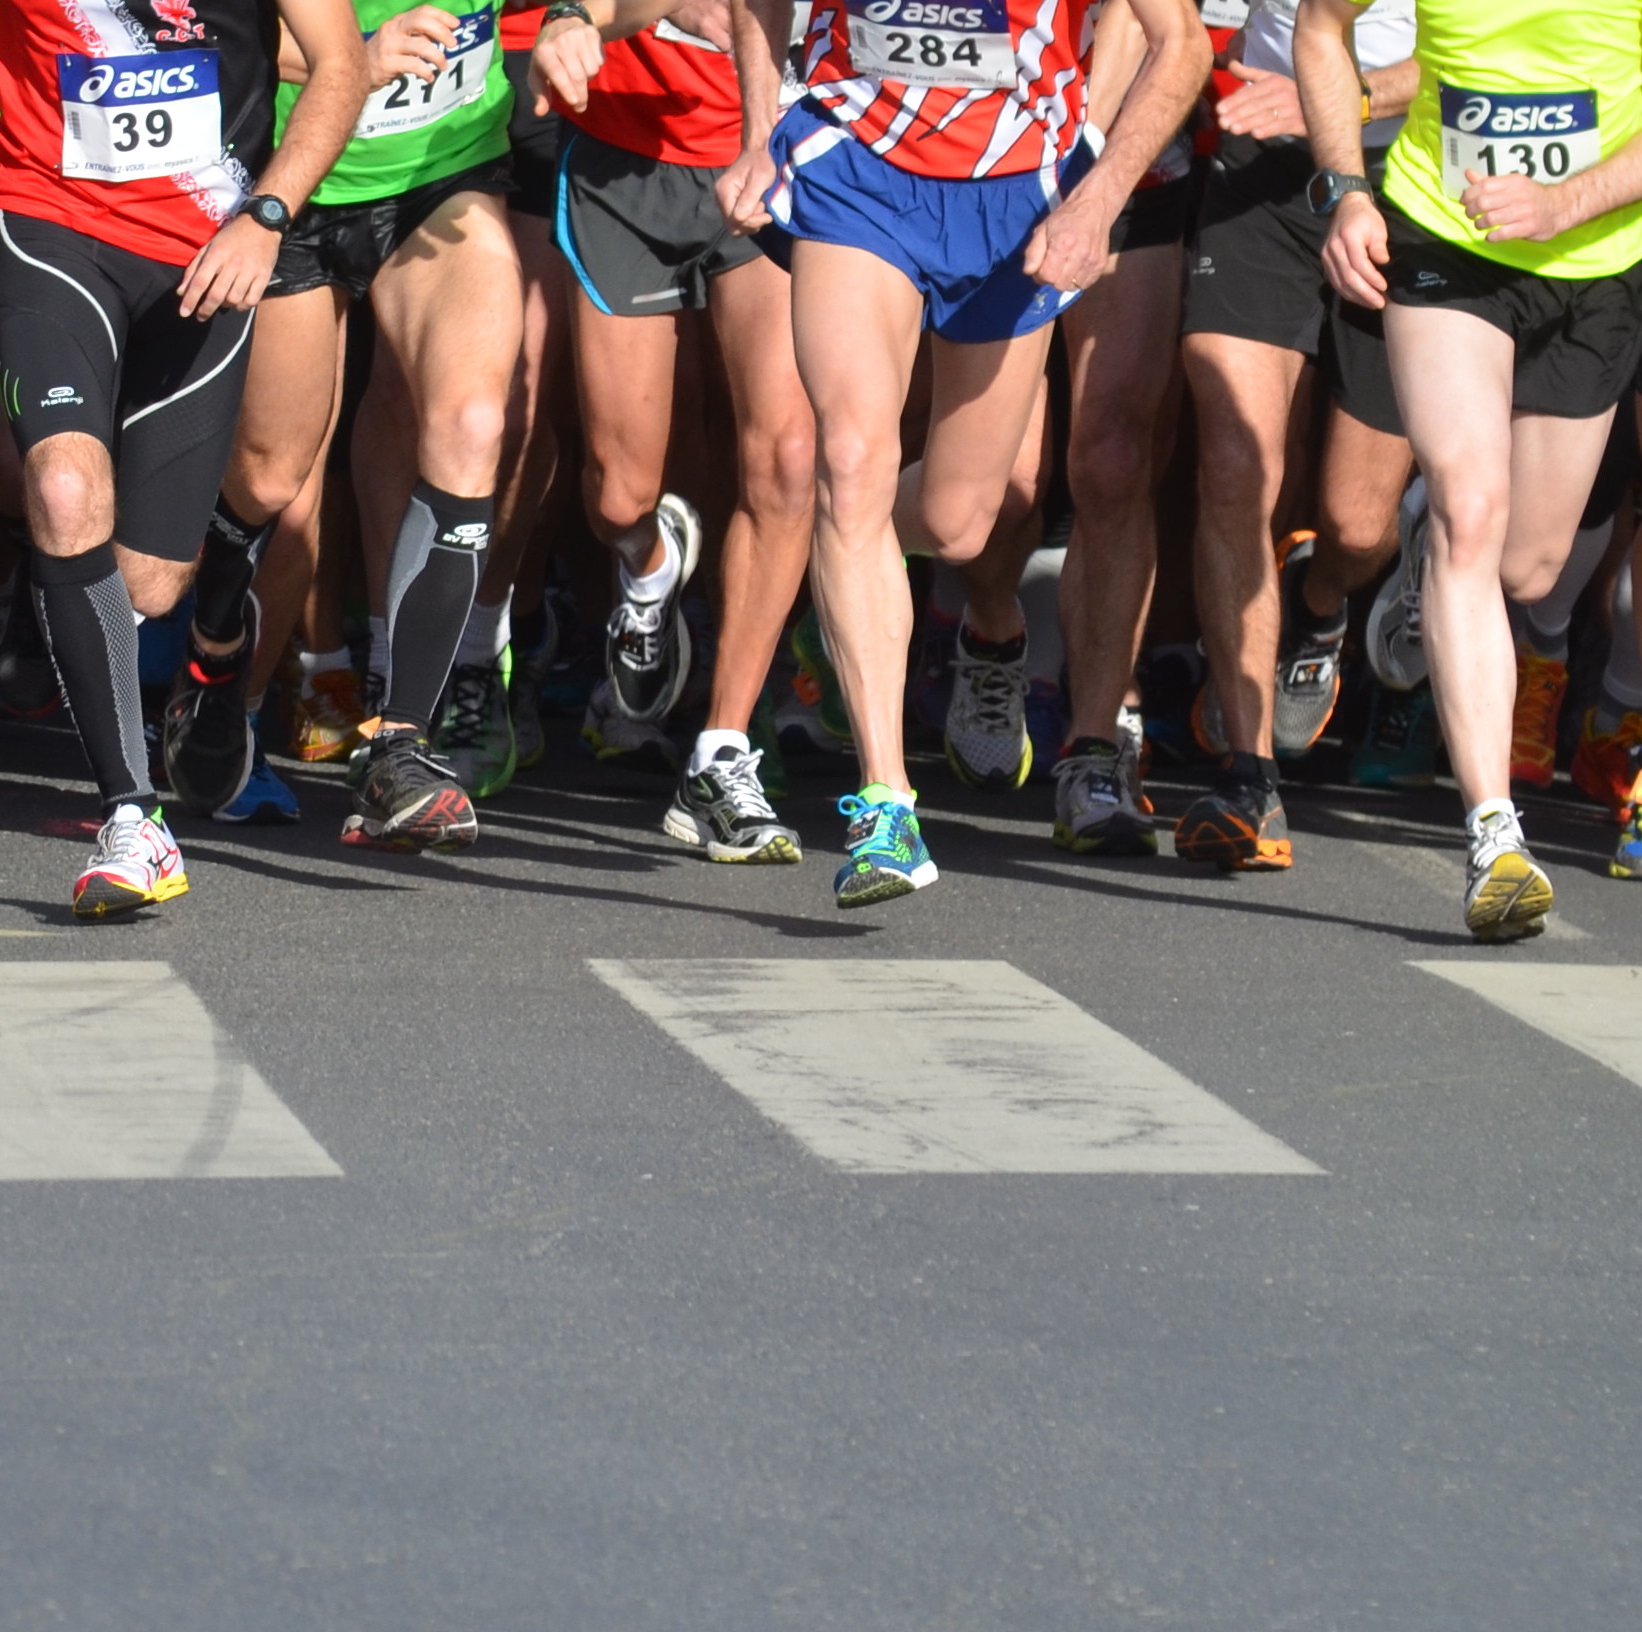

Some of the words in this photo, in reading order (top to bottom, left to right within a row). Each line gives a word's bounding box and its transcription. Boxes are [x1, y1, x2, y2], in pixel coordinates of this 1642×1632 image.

[885, 32, 983, 67] 284
[112, 109, 173, 152] 39
[1477, 141, 1571, 179] 130
